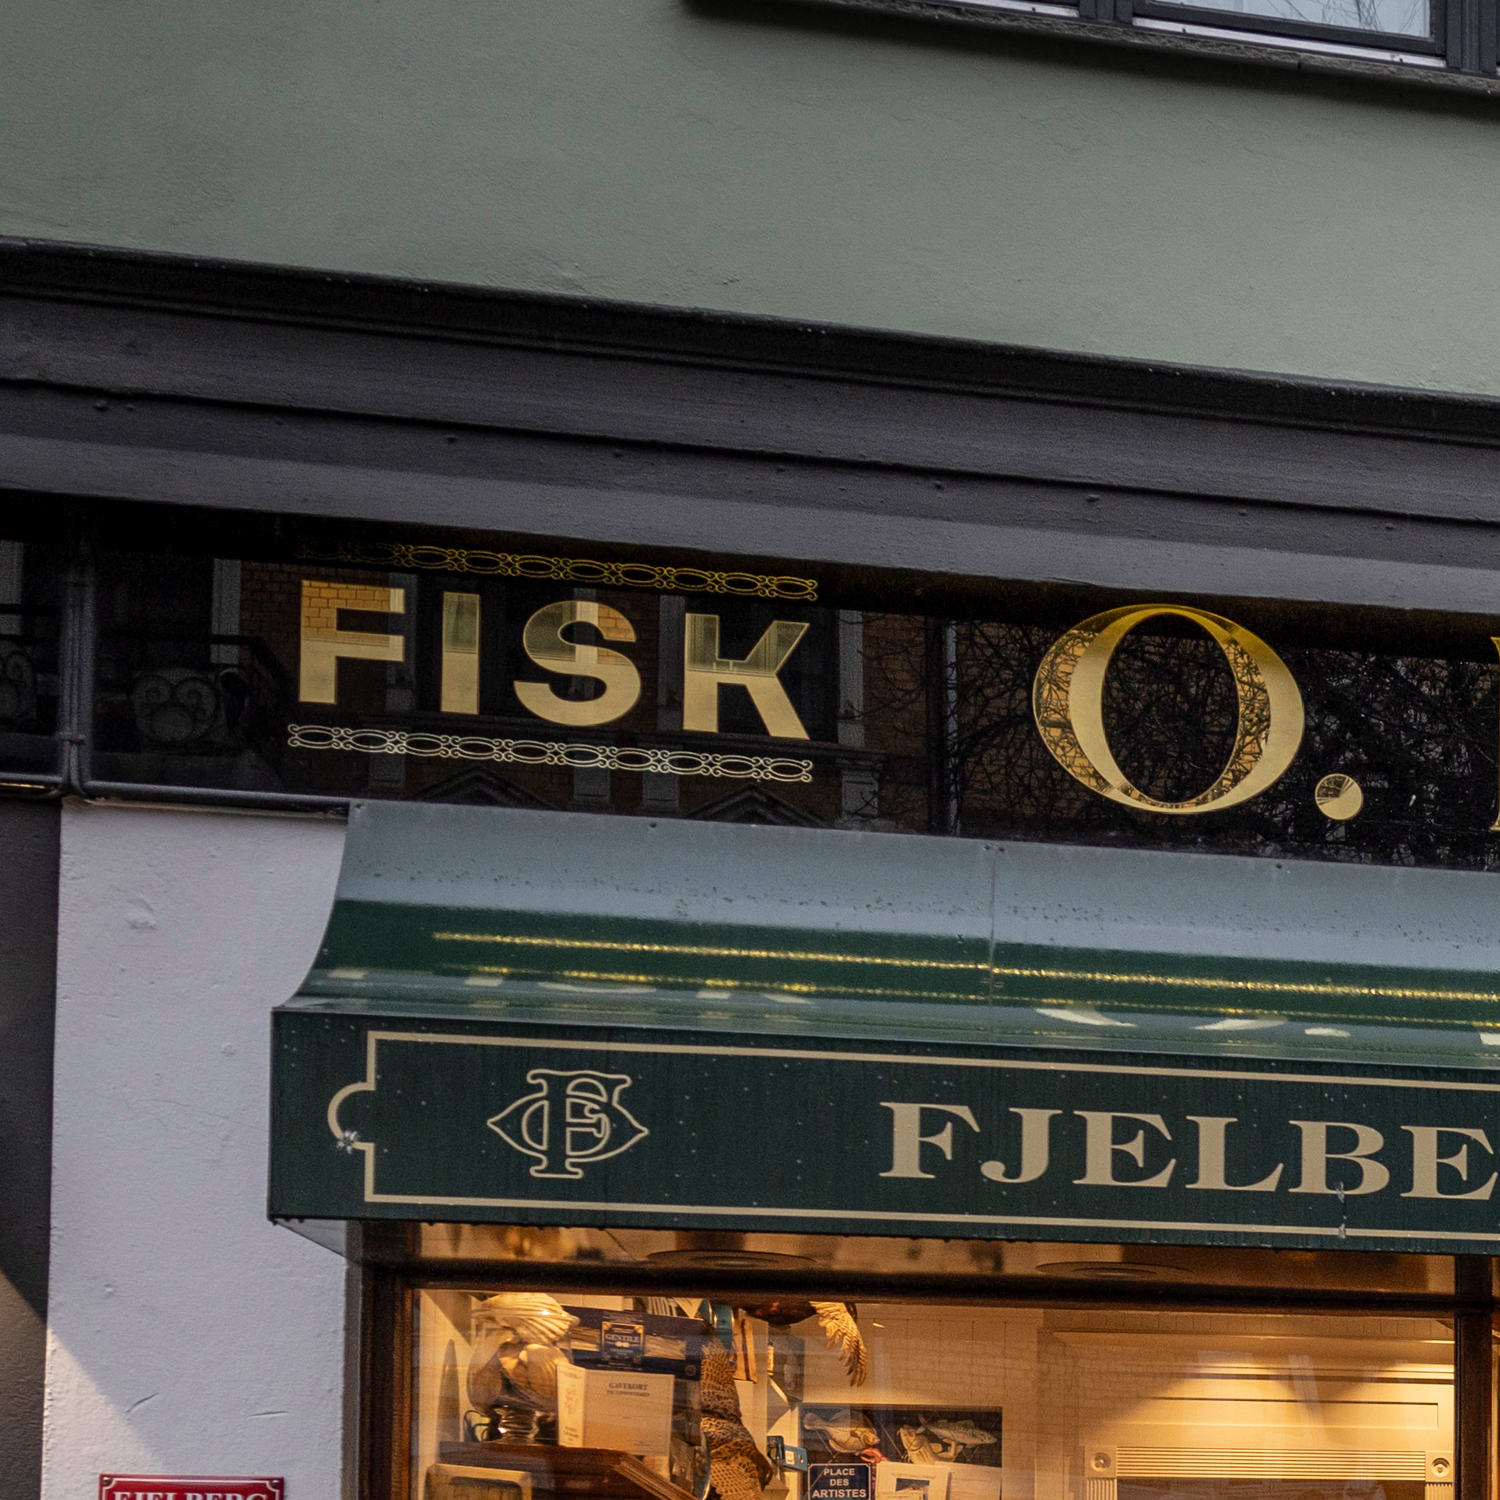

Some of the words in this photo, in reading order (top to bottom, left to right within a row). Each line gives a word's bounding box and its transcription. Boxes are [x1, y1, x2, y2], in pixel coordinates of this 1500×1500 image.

[298, 578, 811, 741] FISK
[1031, 603, 1365, 822] O.
[823, 1467, 856, 1477] PLACE
[829, 1478, 850, 1487] DES
[812, 1488, 867, 1499] ARTISTES
